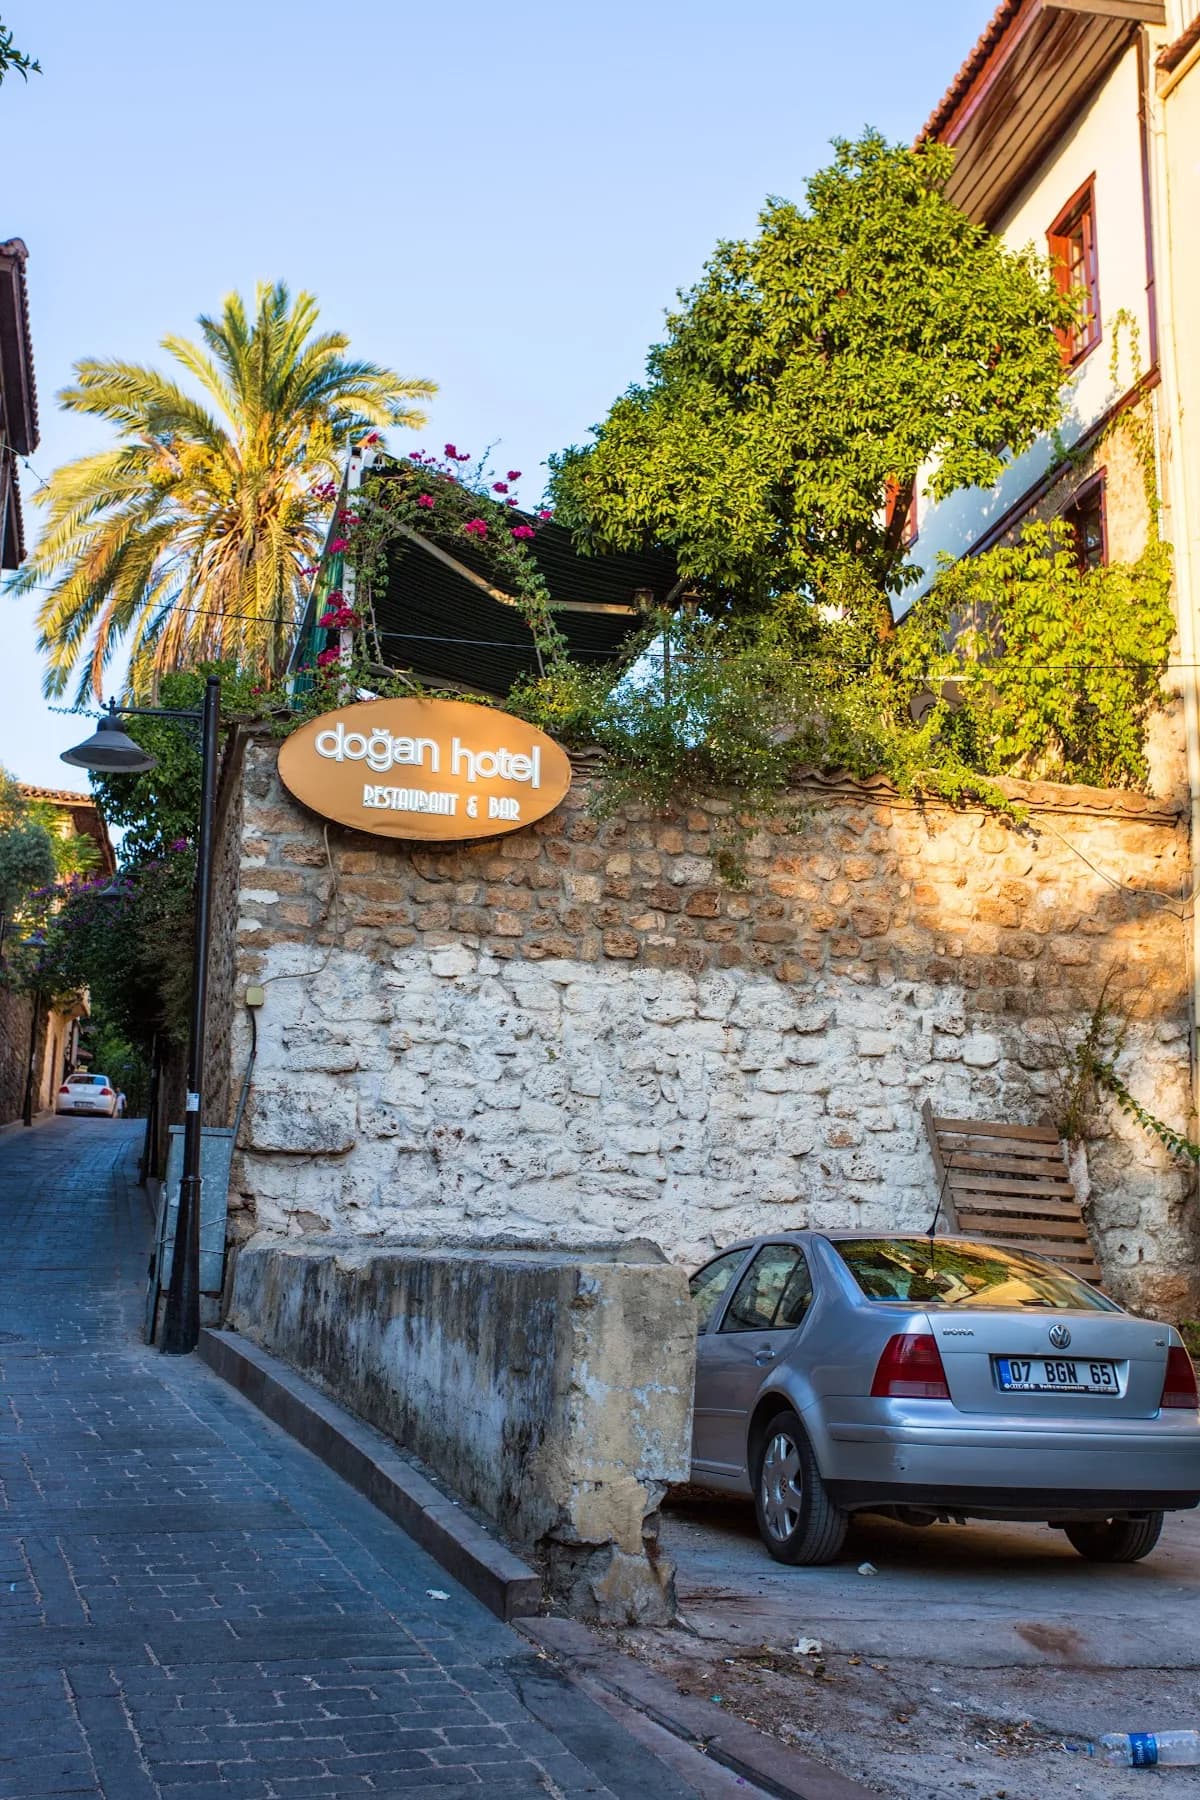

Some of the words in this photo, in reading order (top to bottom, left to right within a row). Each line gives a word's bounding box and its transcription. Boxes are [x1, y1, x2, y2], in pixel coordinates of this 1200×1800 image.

[314, 723, 440, 773] doğan
[451, 737, 541, 789] hotel
[362, 784, 459, 816] RESTAURANT
[466, 795, 478, 818] &
[488, 796, 520, 821] BAR
[1010, 1361, 1031, 1382] 07
[1044, 1362, 1078, 1383] BGN
[1090, 1364, 1111, 1385] 65
